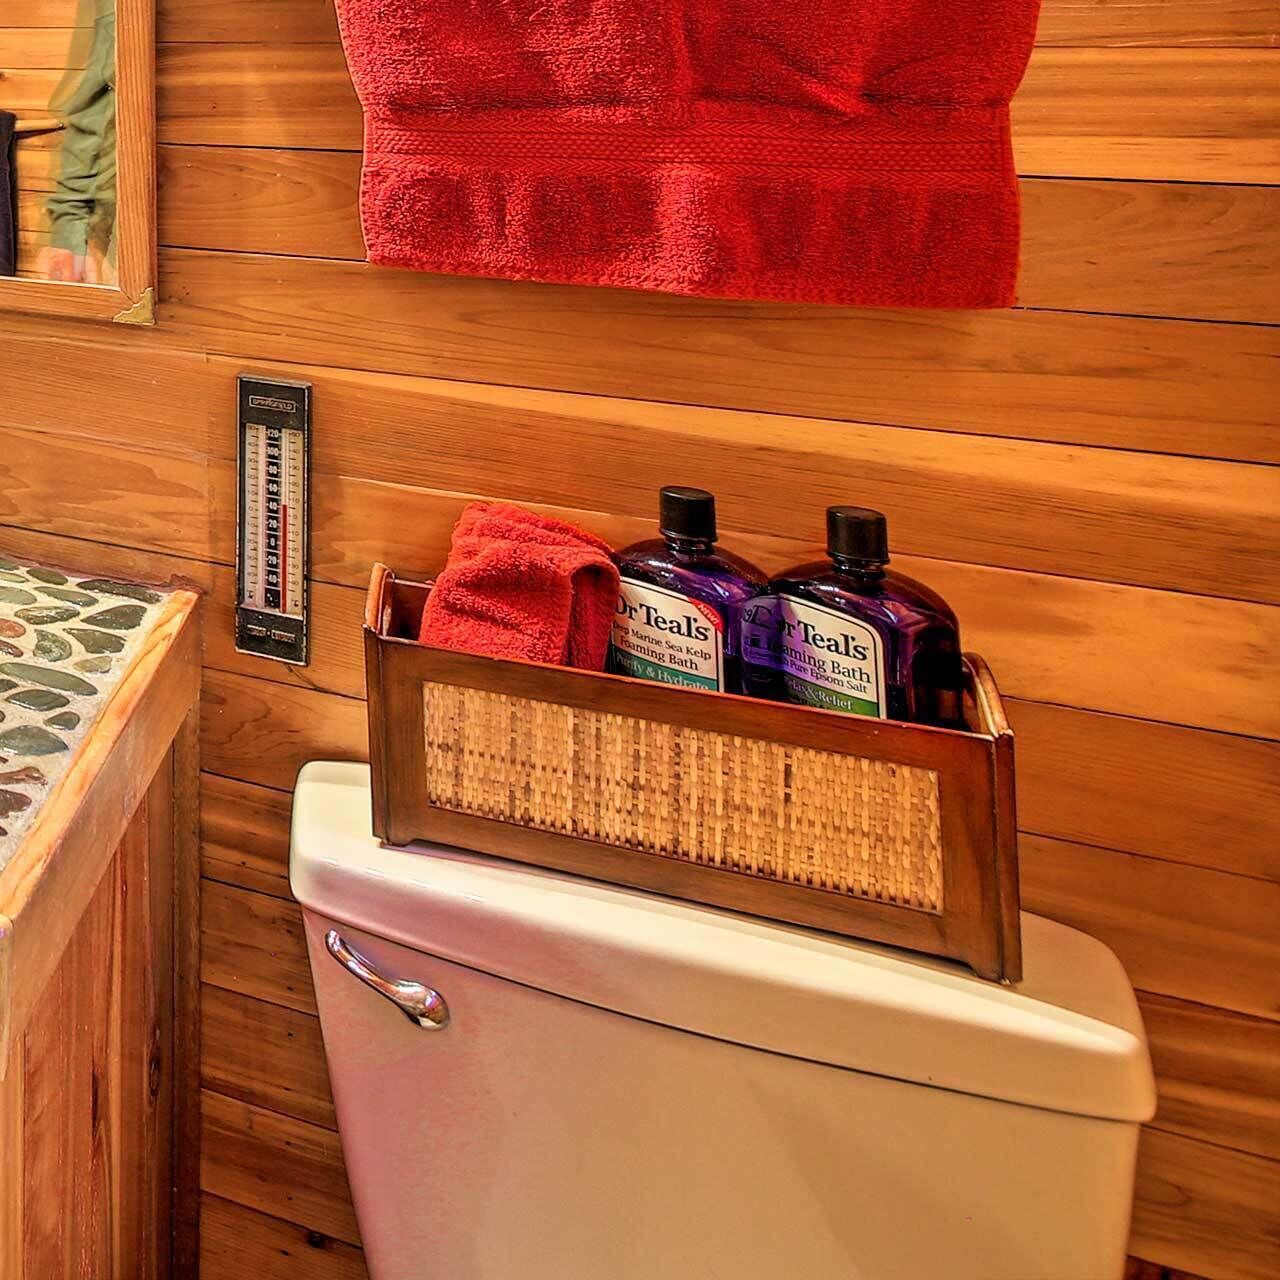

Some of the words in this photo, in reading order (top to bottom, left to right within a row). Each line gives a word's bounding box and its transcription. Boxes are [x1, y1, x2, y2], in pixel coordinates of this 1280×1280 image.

[639, 603, 709, 641] Teal's
[620, 635, 666, 664] Foaming
[669, 653, 699, 671] Bath
[631, 629, 663, 647] Marine
[665, 640, 683, 653] Sea
[686, 646, 712, 661] Kelp
[797, 620, 869, 661] Teal's
[810, 668, 844, 688] Epsom
[846, 682, 868, 694] Salt
[831, 660, 872, 684] Bath
